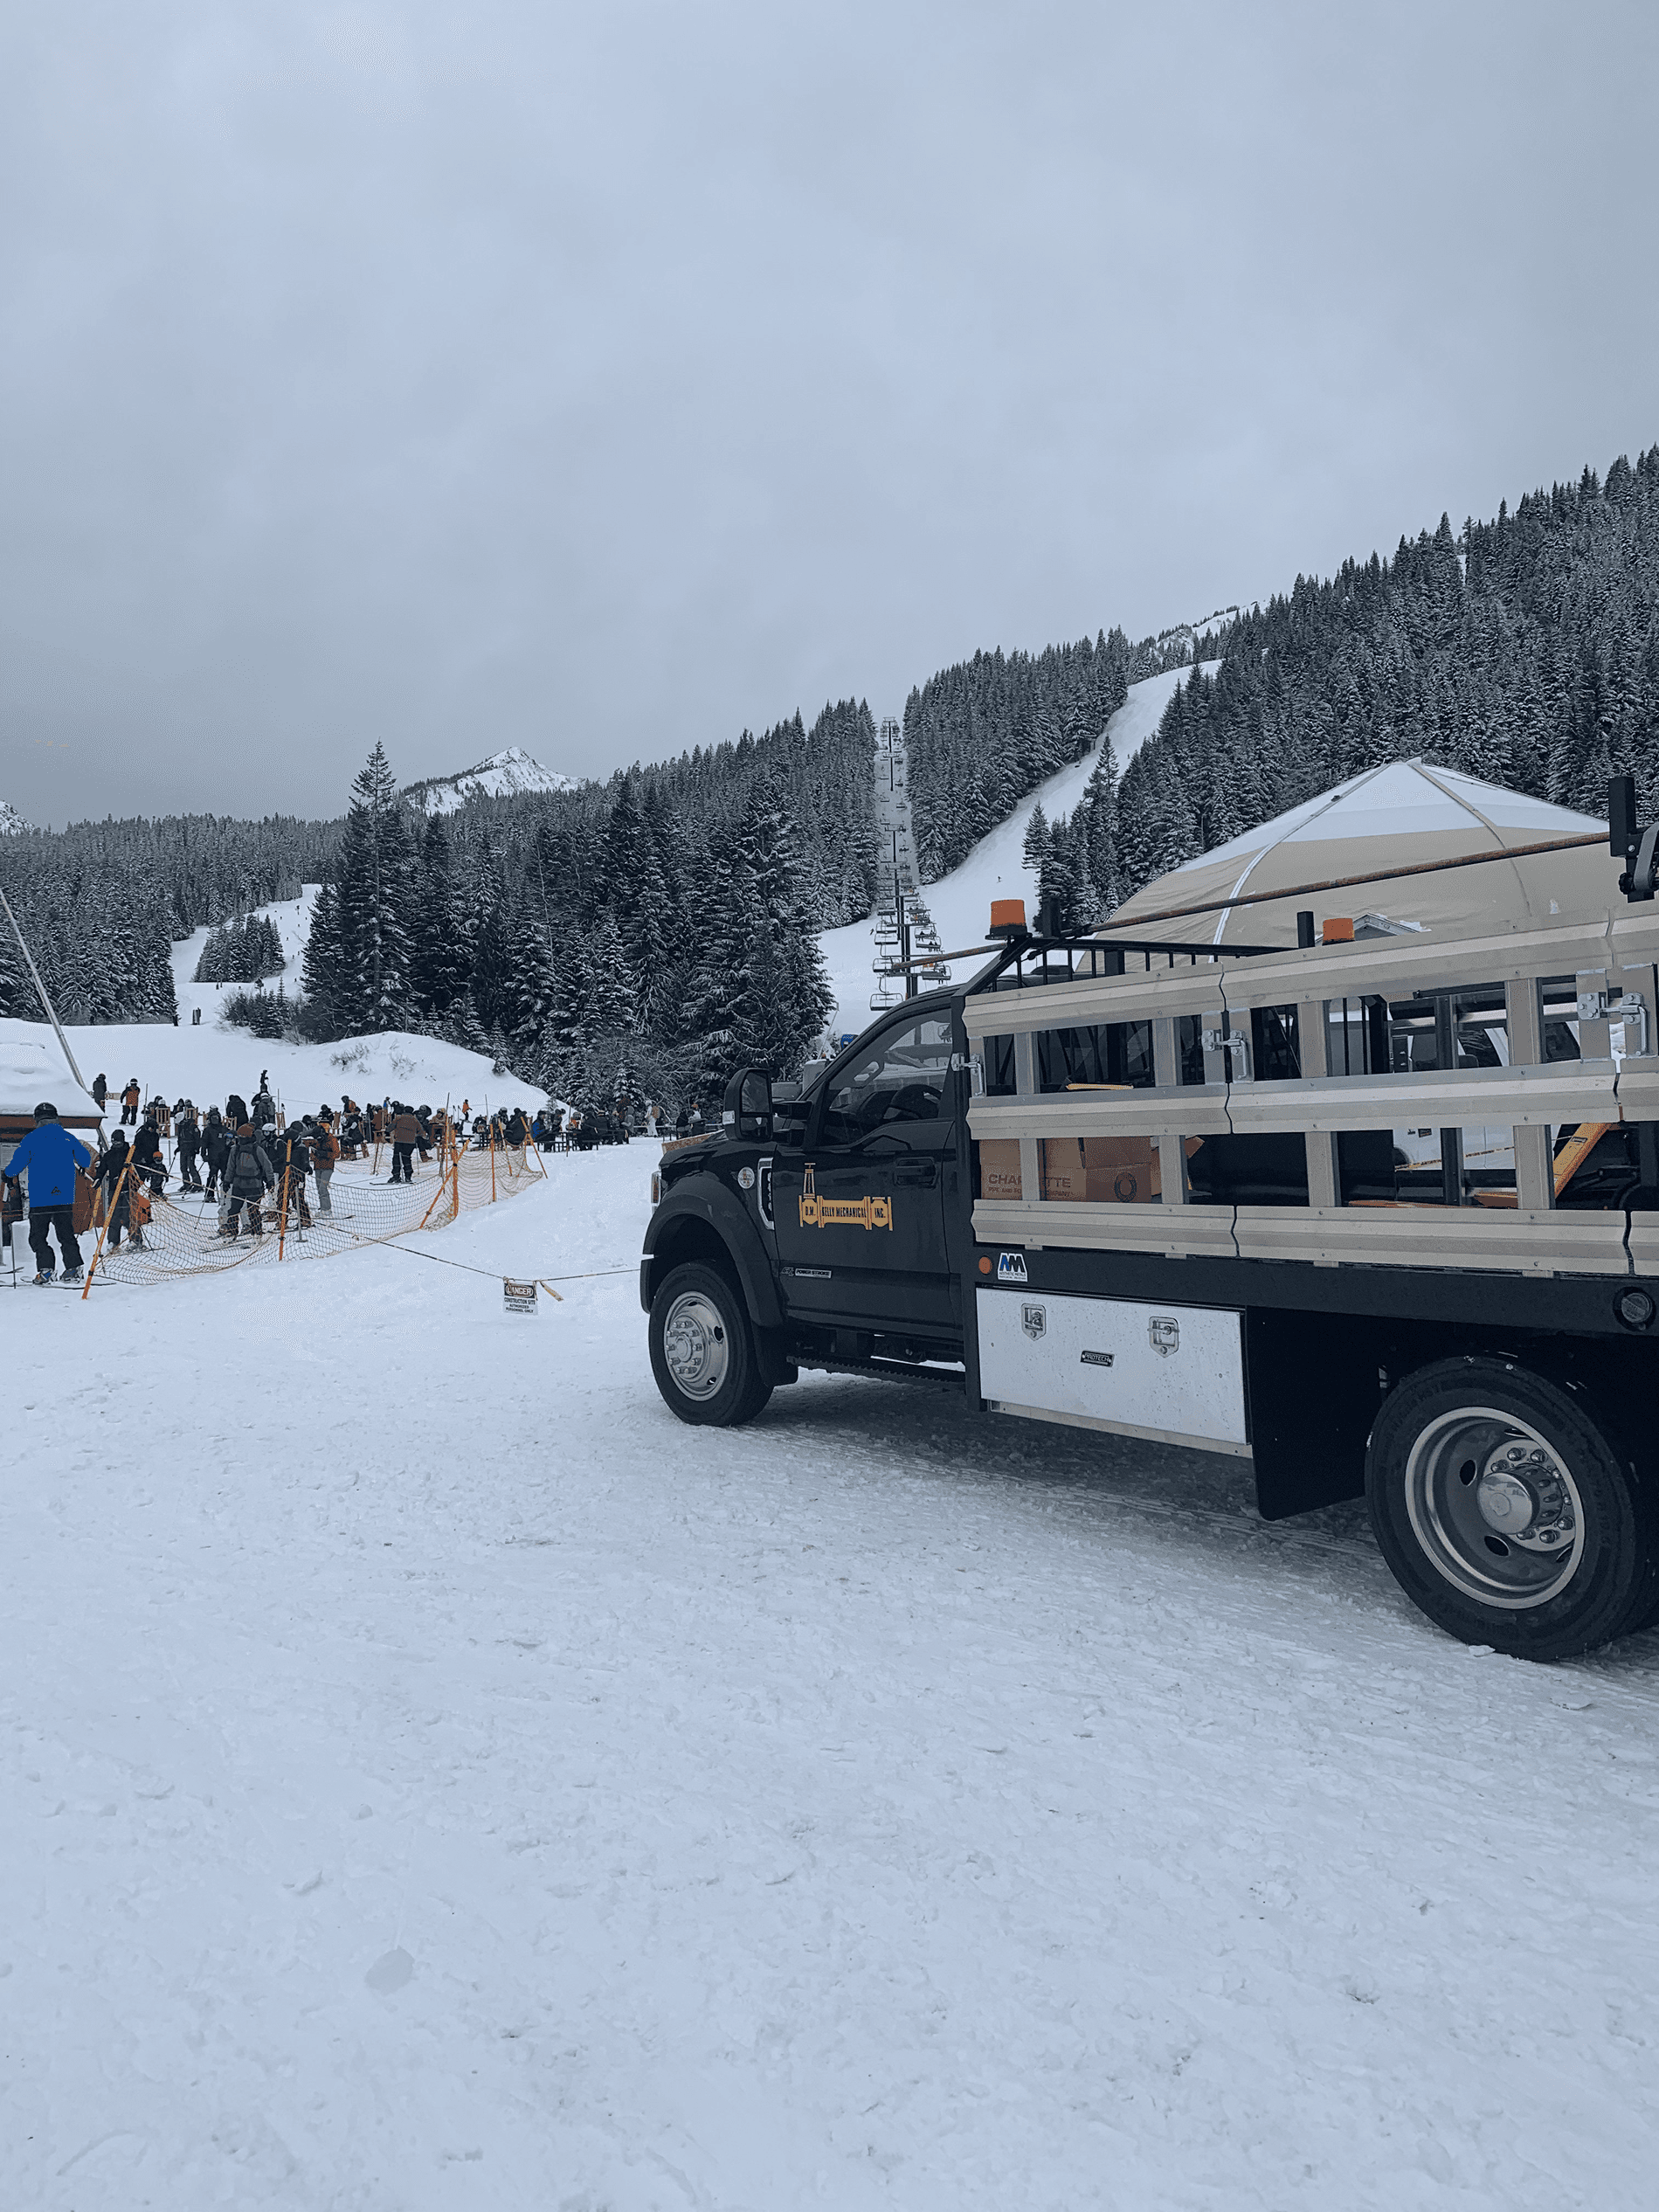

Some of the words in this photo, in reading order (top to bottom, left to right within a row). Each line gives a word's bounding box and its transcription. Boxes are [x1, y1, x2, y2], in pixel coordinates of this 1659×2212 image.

[988, 1174, 1071, 1188] CHATTE
[822, 1206, 835, 1217] KELLY
[836, 1206, 867, 1218] MECHANICAL
[874, 1207, 887, 1218] INC.
